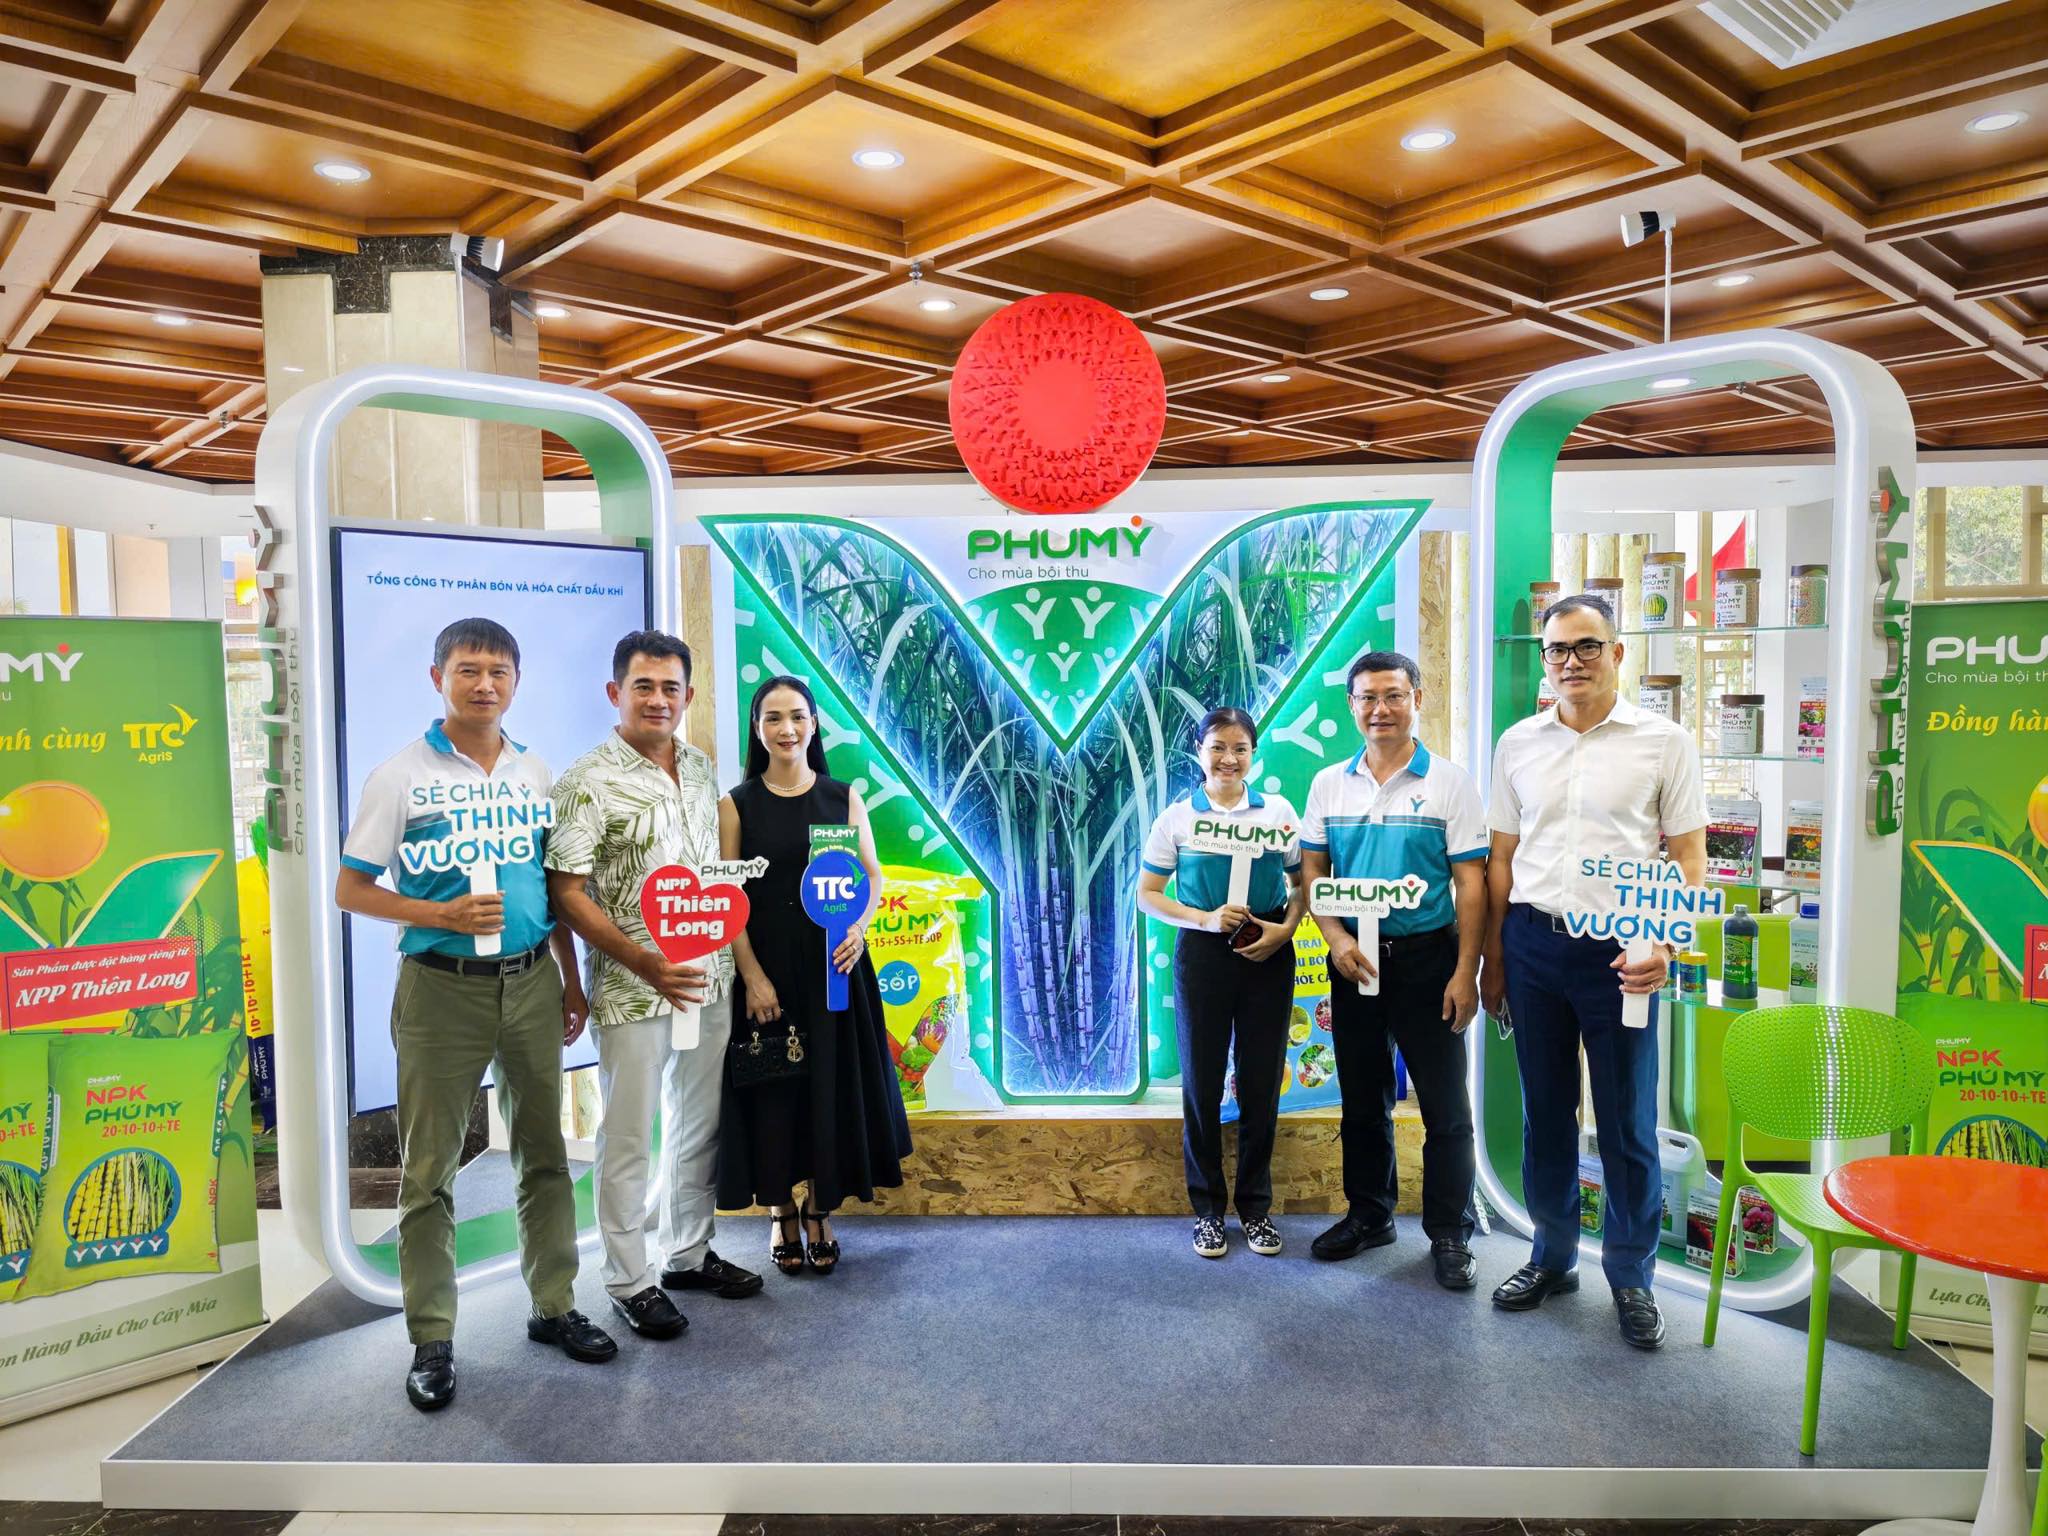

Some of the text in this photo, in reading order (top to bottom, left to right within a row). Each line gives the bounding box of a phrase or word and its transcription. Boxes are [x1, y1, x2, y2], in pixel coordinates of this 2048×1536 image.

[967, 516, 1154, 560] PHUMY
[367, 571, 400, 586] TỔNG
[403, 575, 437, 588] CÔNG
[440, 579, 454, 588] TY
[457, 579, 487, 590] PHÂN
[490, 580, 513, 591] BÓN
[516, 581, 529, 592] VÀ
[532, 581, 554, 593] HÓA
[556, 582, 582, 594] CHẤT
[607, 585, 624, 596] KHÍ
[967, 565, 1089, 582] Cho mùa bội thu
[288, 627, 298, 672] thu
[1866, 466, 1910, 837] PHUMY
[248, 504, 292, 852] PHUMY
[1925, 672, 1957, 684] Cho
[1964, 671, 1998, 683] mùa
[2003, 670, 2029, 684] bội
[1927, 704, 1999, 736] Đồng
[42, 727, 107, 753] cùng
[123, 722, 187, 749] TTC
[138, 751, 173, 764] AgriS
[450, 781, 513, 803] CHIA
[294, 803, 304, 855] Cho
[449, 801, 552, 835] THỊNH
[813, 829, 857, 838] PHUMY
[1194, 820, 1296, 847] PHUMY
[404, 836, 530, 871] VƯỢNG
[1193, 839, 1209, 847] Cho
[1246, 845, 1259, 853] thu
[701, 860, 766, 877] PHUMY
[1617, 861, 1682, 883] CHIA
[656, 878, 691, 891] NPP
[813, 876, 857, 900] TTC
[1315, 880, 1422, 903] PHUMY
[656, 895, 731, 914] Thiên
[823, 903, 848, 914] AgriS
[1315, 903, 1332, 911] Cho
[1370, 905, 1385, 913] thu
[1614, 885, 1722, 917] THỊNH
[660, 919, 724, 940] Long
[864, 914, 902, 934] HÚ
[1566, 911, 1693, 945] VƯỢNG
[15, 970, 191, 1008] NPP Thiên Long
[878, 971, 919, 993] SOP
[1937, 1049, 2004, 1068] NPK
[1940, 1069, 2046, 1087] PHÚ MỸ
[86, 1084, 149, 1107] NPK
[1960, 1089, 2047, 1104] 20-10-10+TE
[85, 1100, 183, 1125] PHÚ MỸ
[102, 1119, 181, 1139] 20-10-10+TE
[1928, 1288, 1962, 1305] Lựa
[116, 1317, 149, 1336] Cho
[152, 1307, 184, 1326] Cây
